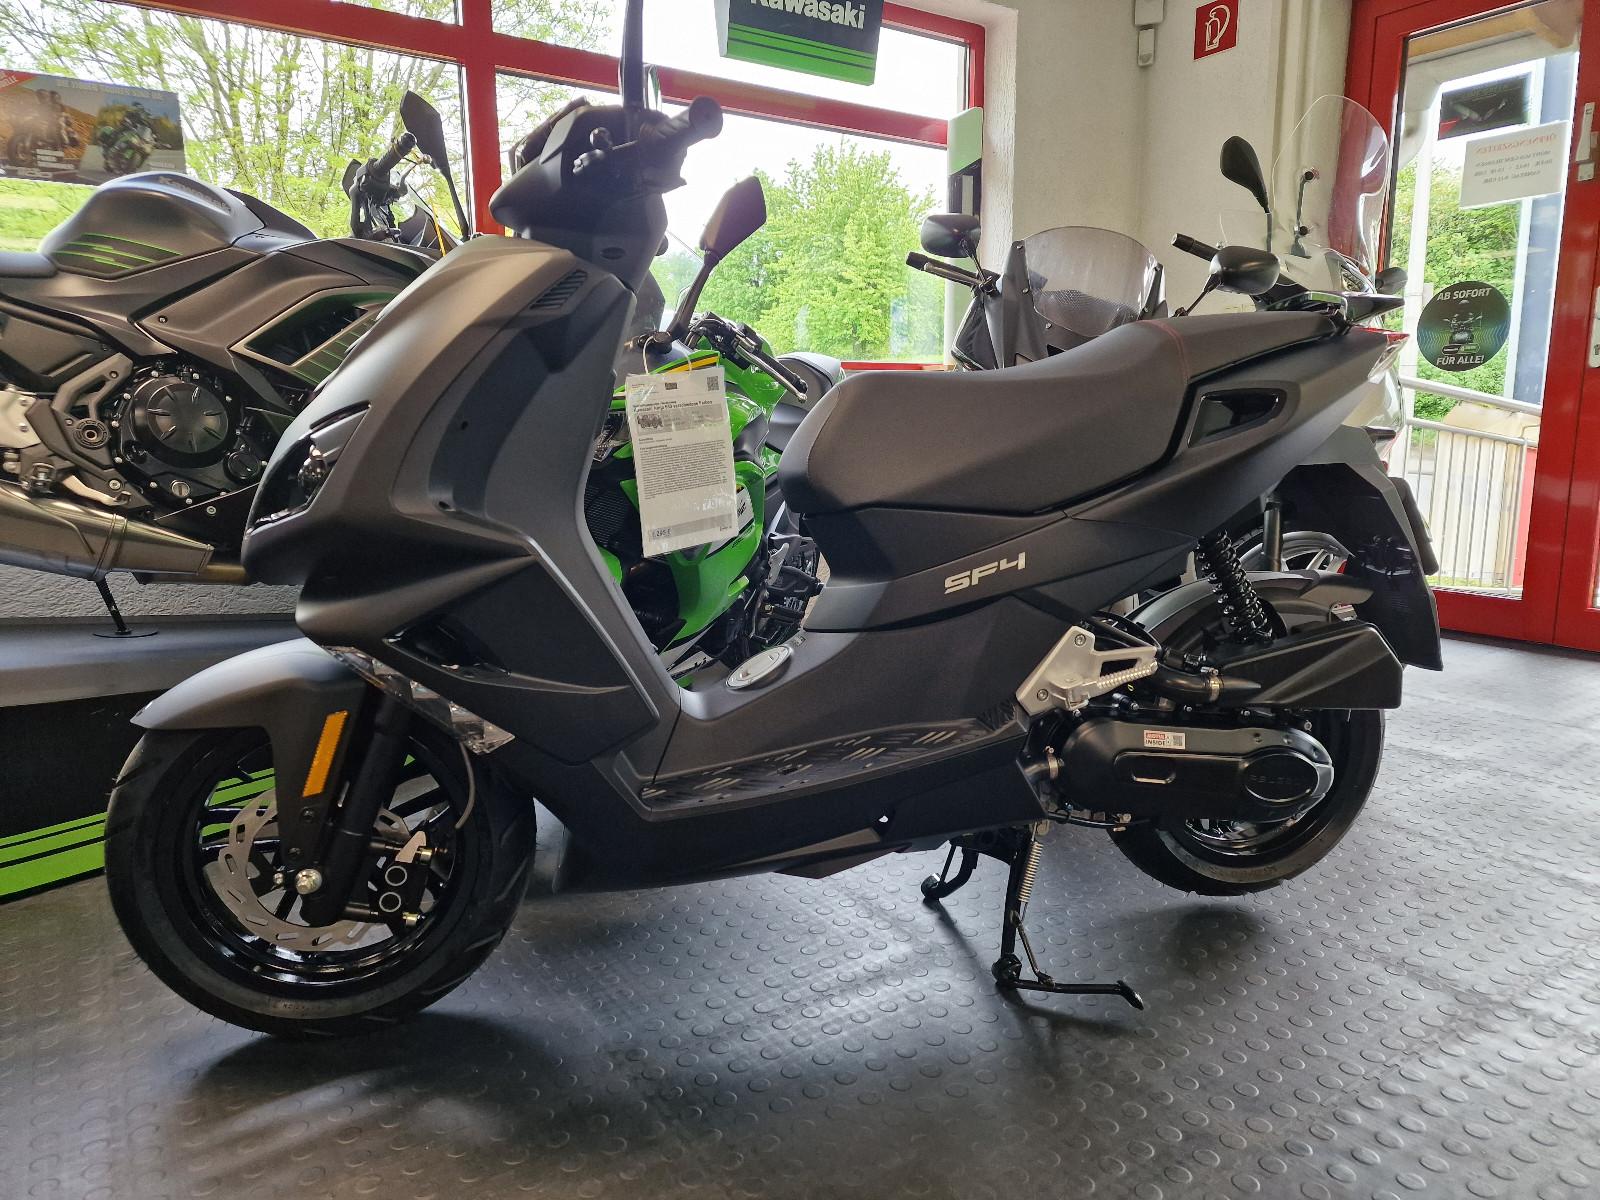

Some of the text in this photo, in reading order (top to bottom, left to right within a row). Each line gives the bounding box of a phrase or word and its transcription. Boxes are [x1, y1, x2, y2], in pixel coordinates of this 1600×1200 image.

[751, 0, 865, 30] awasaki
[1437, 287, 1492, 301] AB SOFORT
[1436, 355, 1484, 366] FÜR ALLE!
